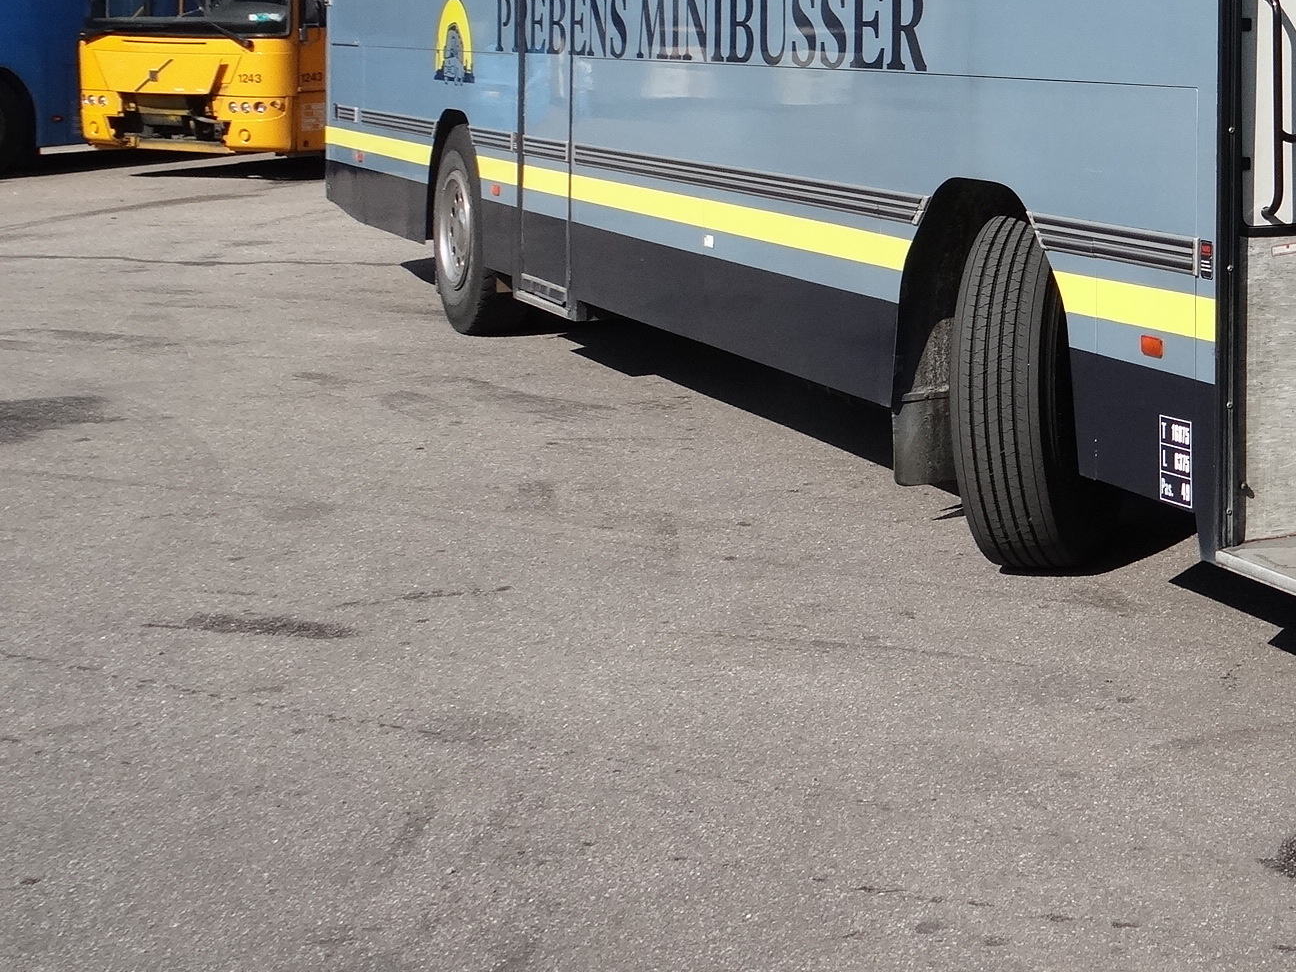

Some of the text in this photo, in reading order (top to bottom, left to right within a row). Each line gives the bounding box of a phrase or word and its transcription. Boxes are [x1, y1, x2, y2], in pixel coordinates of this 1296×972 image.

[238, 73, 262, 84] 1243
[300, 72, 323, 83] 1243
[1161, 421, 1167, 440] T
[1162, 449, 1168, 467] L
[1161, 477, 1174, 497] Pas.
